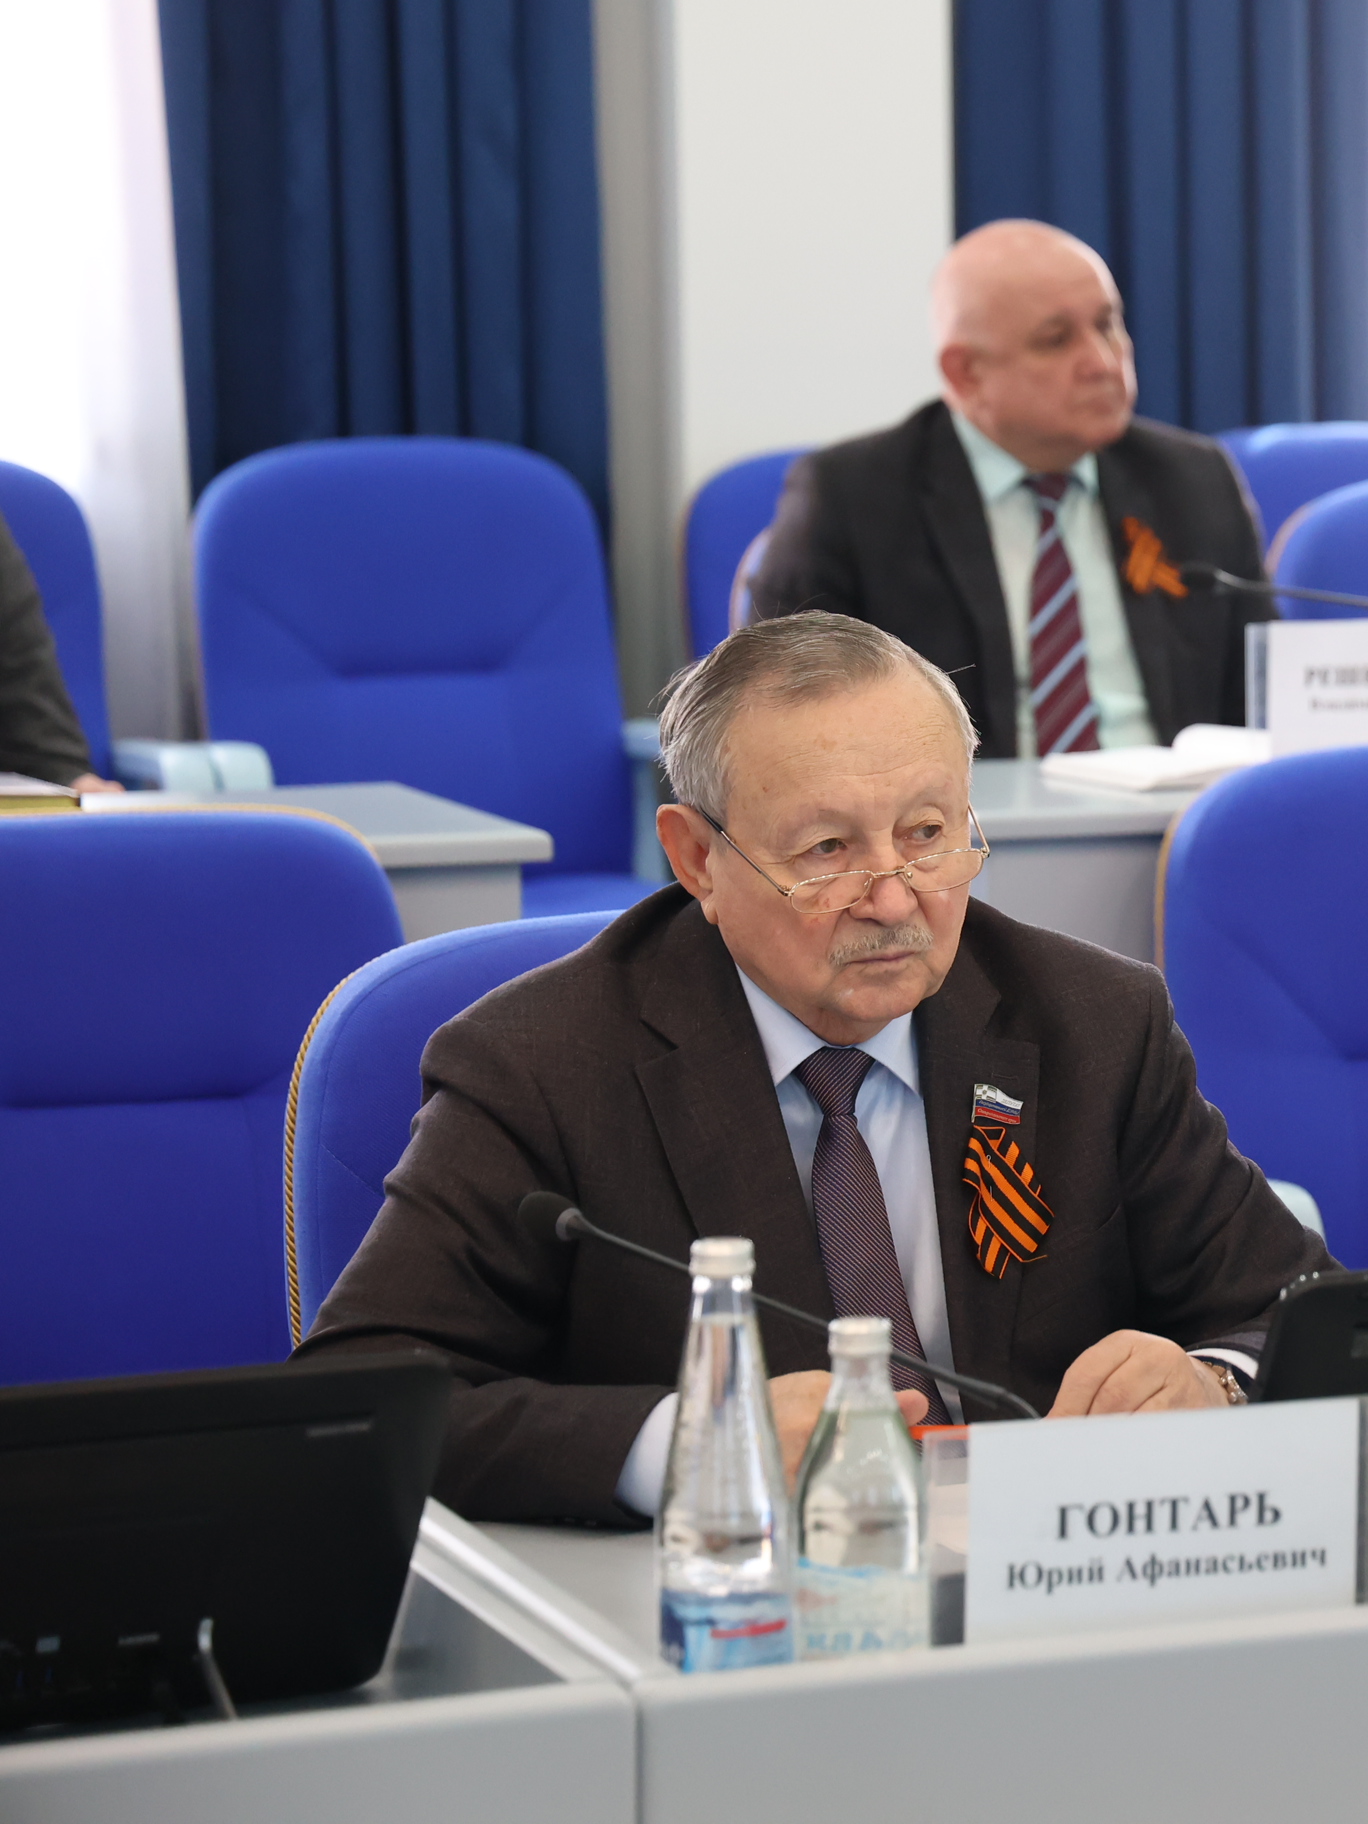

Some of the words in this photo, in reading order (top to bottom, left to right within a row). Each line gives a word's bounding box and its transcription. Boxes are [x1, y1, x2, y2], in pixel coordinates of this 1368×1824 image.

[1056, 1490, 1282, 1540] ГОНТАРЬ
[1006, 1560, 1105, 1595] Юрий
[1116, 1546, 1328, 1587] Афанасьевич
